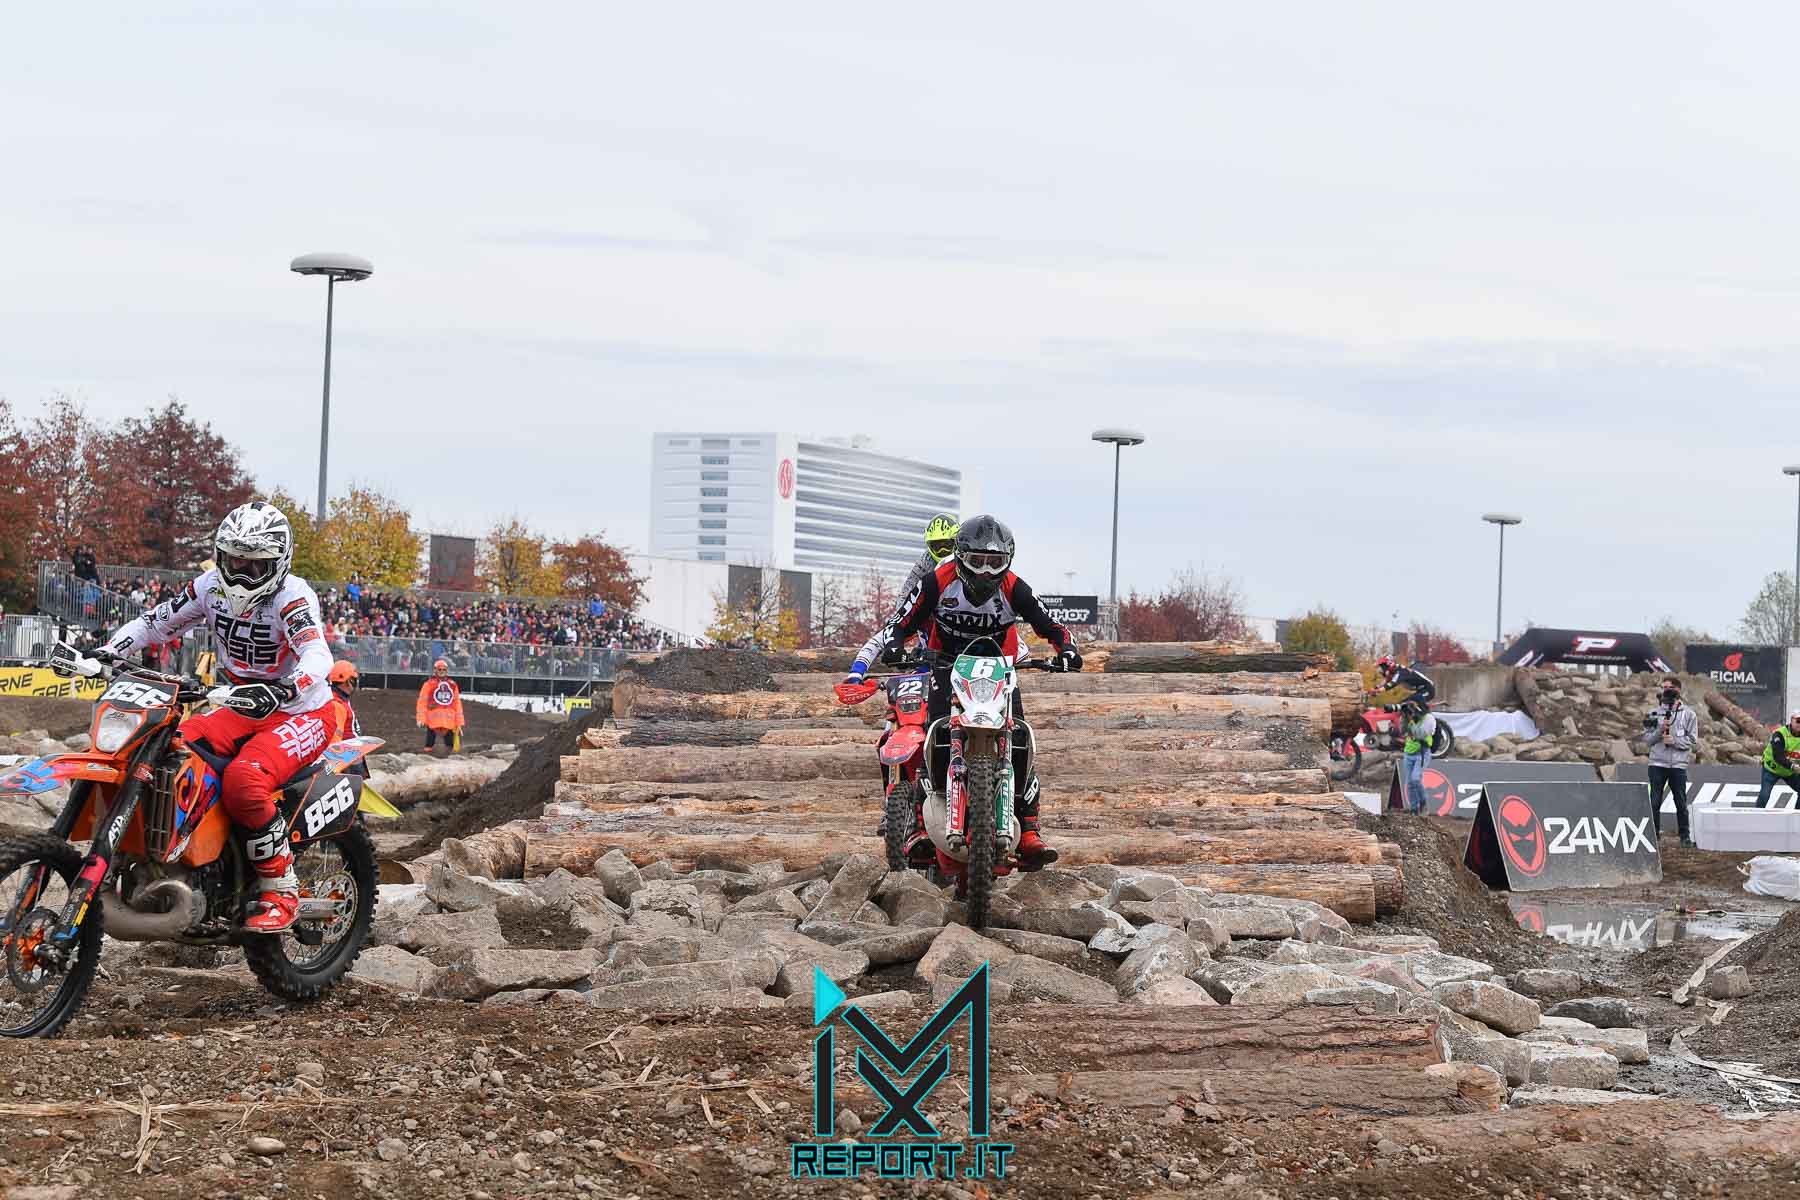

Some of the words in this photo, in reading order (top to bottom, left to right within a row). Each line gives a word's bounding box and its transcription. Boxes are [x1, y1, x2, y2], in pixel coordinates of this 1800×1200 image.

[971, 659, 997, 678] 6
[1710, 670, 1757, 684] EICMA
[101, 681, 171, 709] 856
[897, 681, 923, 698] 22
[304, 776, 355, 838] 856
[1543, 816, 1657, 854] 24MX
